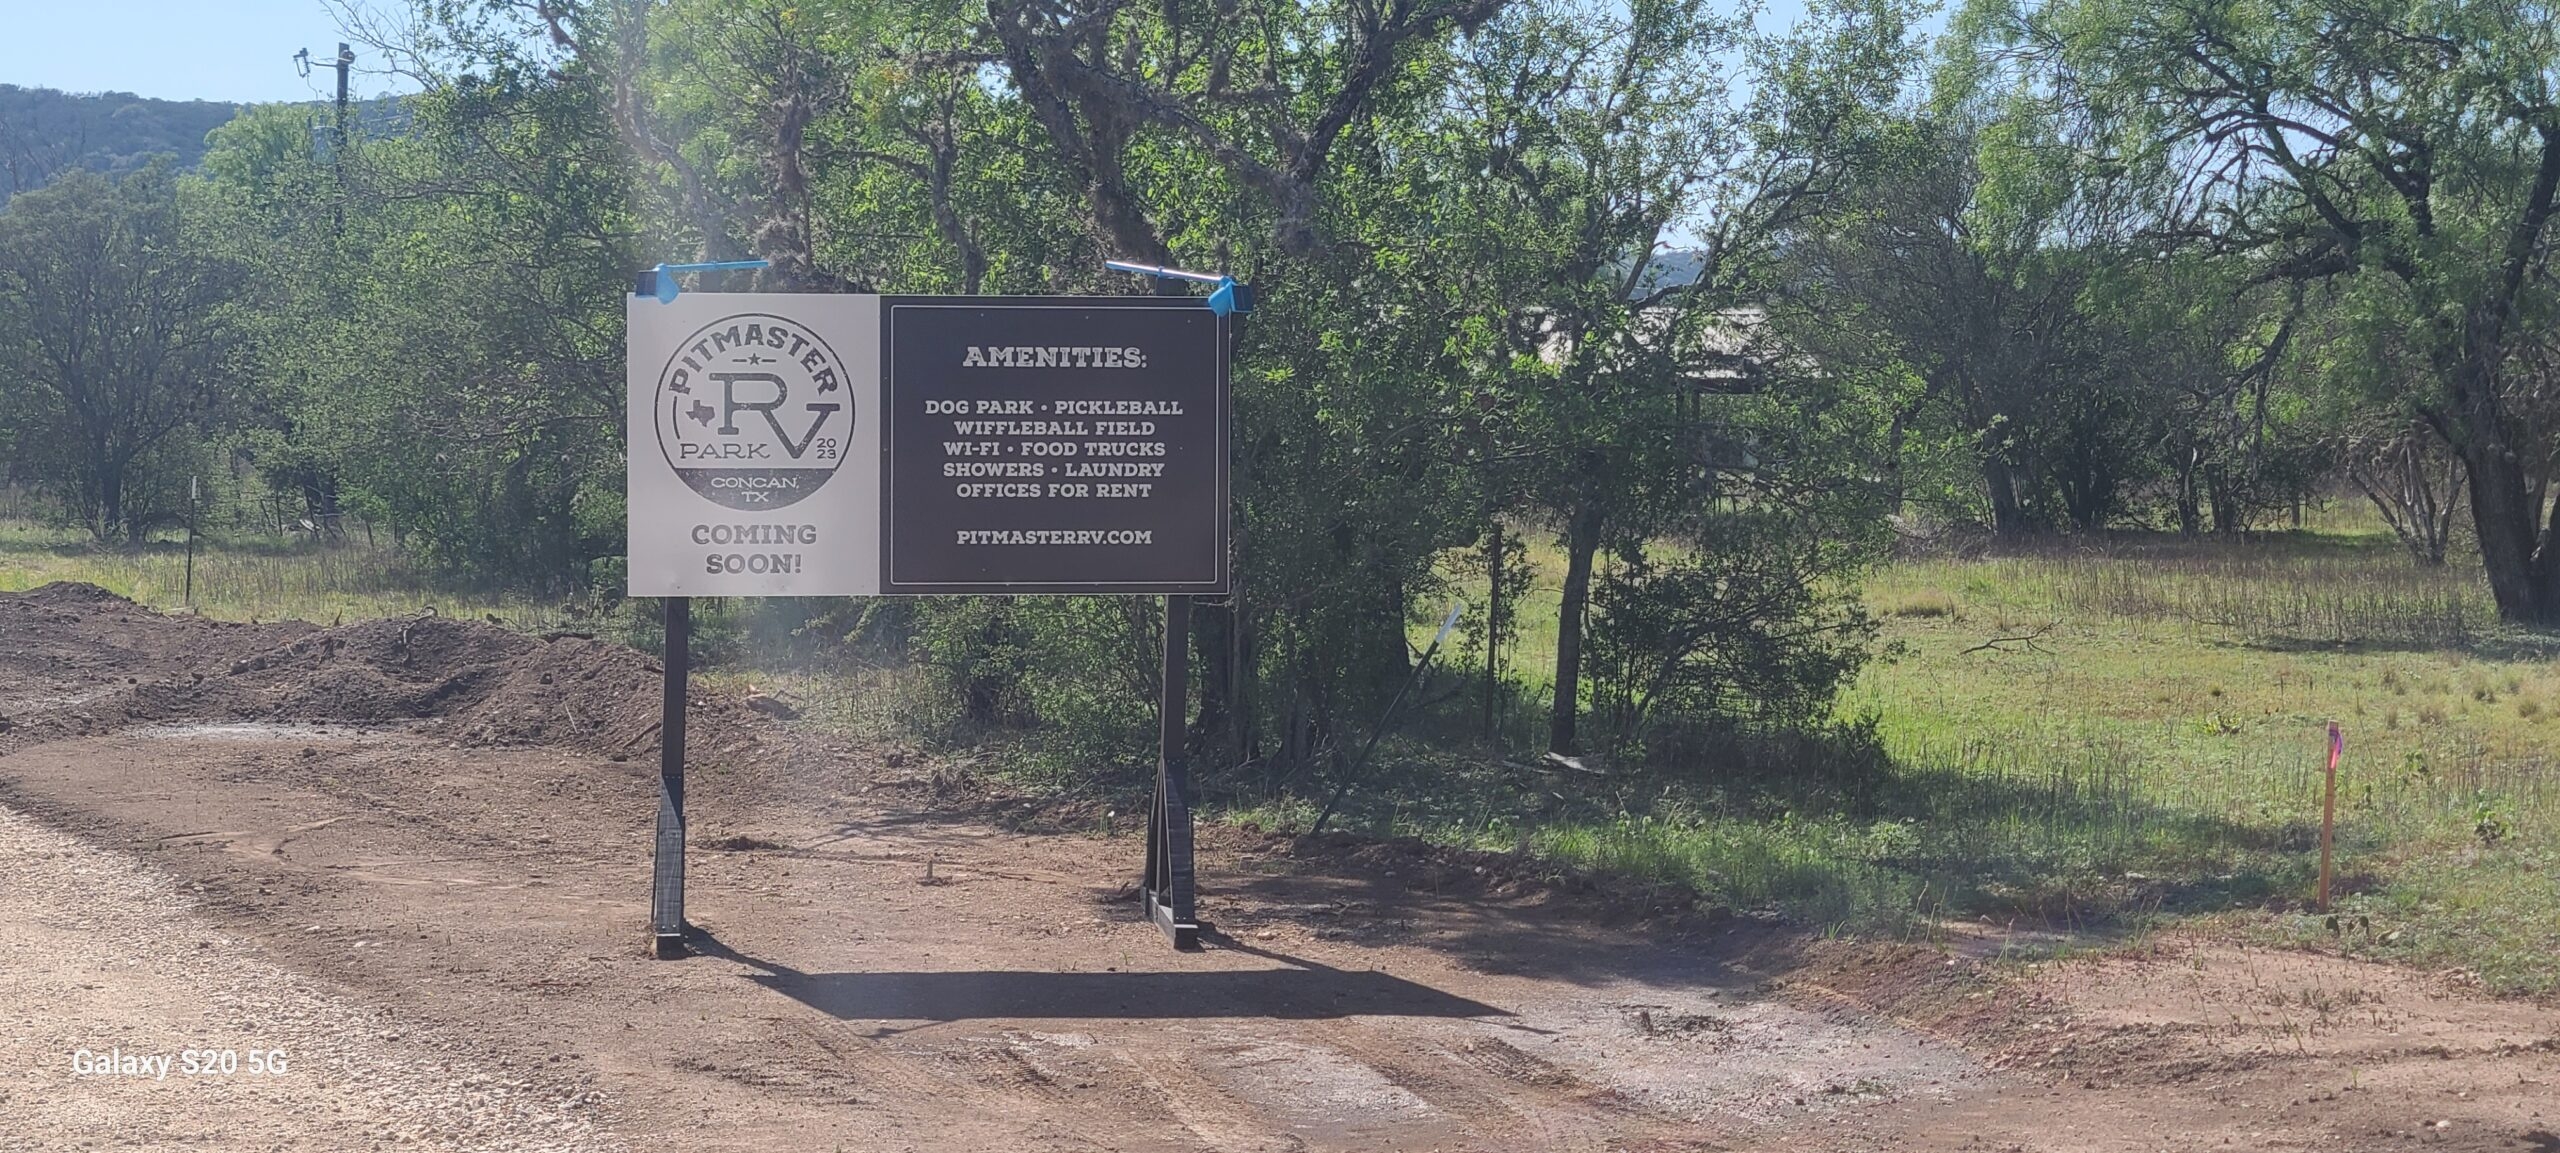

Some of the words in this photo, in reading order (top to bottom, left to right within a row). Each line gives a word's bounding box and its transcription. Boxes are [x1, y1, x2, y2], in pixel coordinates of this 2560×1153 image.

[669, 324, 838, 396] PITMASTER
[962, 346, 1147, 368] AMENITIES:
[925, 400, 969, 415] DOG
[976, 400, 1034, 415] PARK
[1054, 400, 1184, 415] PICKLEBALL
[709, 372, 841, 459] RV
[954, 421, 1089, 436] WIFFLEBALL
[1095, 421, 1156, 436] FIELD
[680, 443, 771, 459] PARK
[816, 438, 837, 449] 20
[943, 442, 1001, 456] WI-FI
[1020, 442, 1078, 456] FOOD
[1084, 442, 1166, 456] TRUCKS
[816, 449, 837, 460] 23
[943, 462, 1045, 477] SHOWERS
[1064, 462, 1166, 477] LAUNDRY
[711, 477, 800, 490] CONCAN,
[956, 483, 1042, 498] OFFICES
[1048, 483, 1090, 498] FOR
[1095, 483, 1152, 498] RENT
[741, 491, 769, 503] TX
[691, 524, 817, 545] COMING
[956, 530, 1153, 545] PITMASTERRV.COM
[706, 553, 802, 574] SOON!
